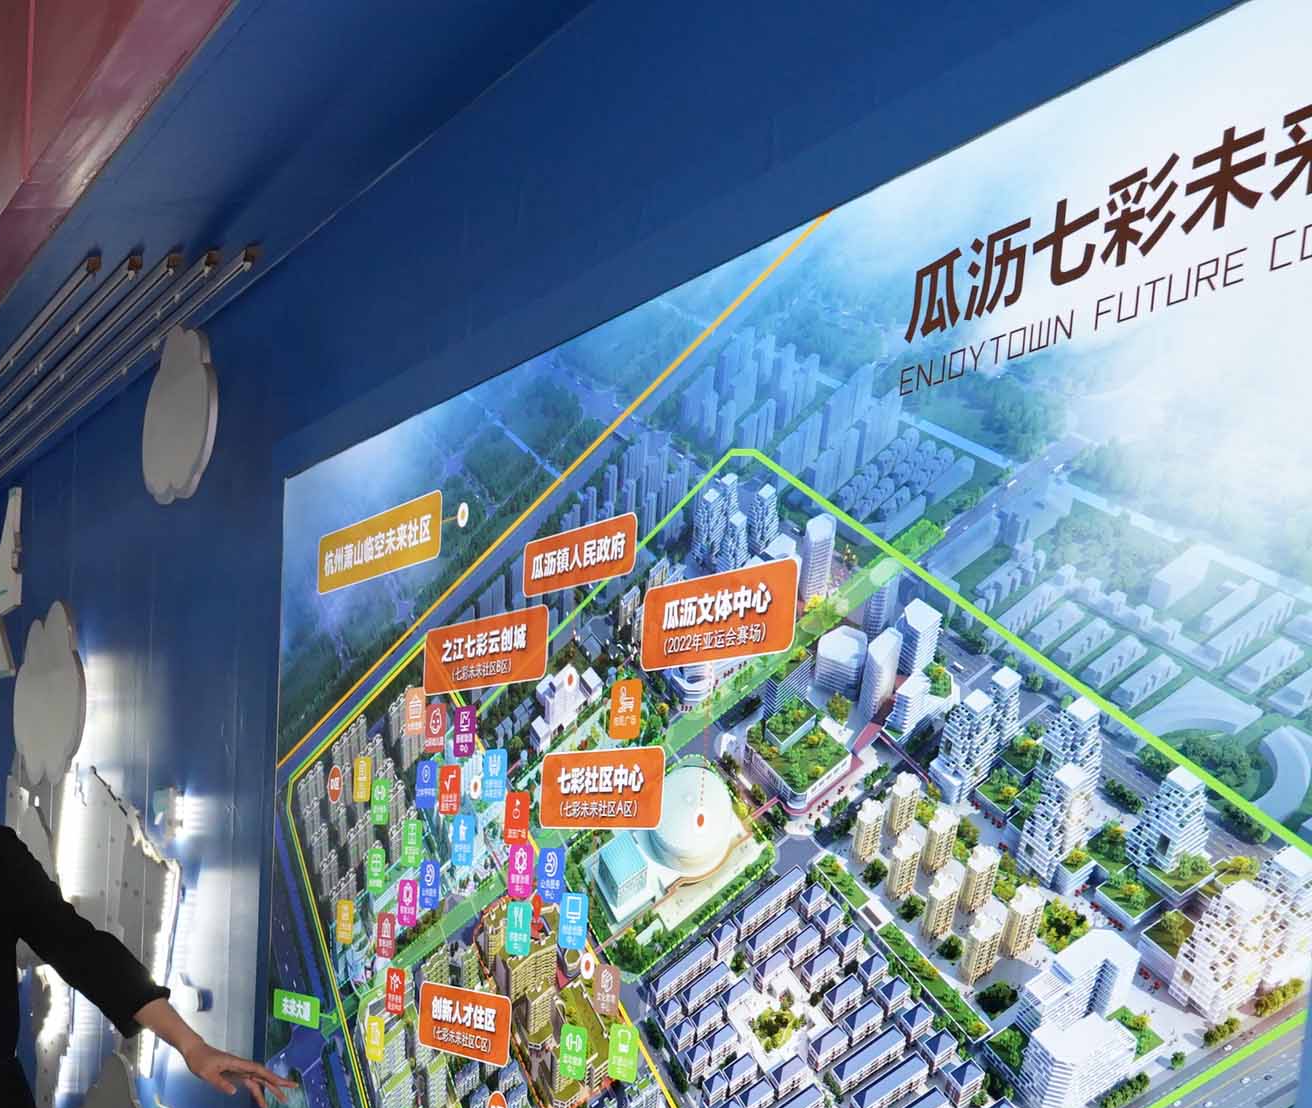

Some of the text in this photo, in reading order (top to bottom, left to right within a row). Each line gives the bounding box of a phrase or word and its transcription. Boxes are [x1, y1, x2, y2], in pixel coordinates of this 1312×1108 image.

[899, 309, 1074, 396] ENJOYTOWN
[1094, 247, 1248, 331] FUTURE
[324, 514, 432, 577] 杭州萧山临空未来社区
[531, 532, 626, 581] 瓜沥镇人民政府
[662, 583, 772, 631] 瓜沥文体中心
[441, 624, 527, 663] 之江七彩云创城
[557, 763, 645, 795] 七彩社区中心
[431, 996, 497, 1032] 创新人才住区
